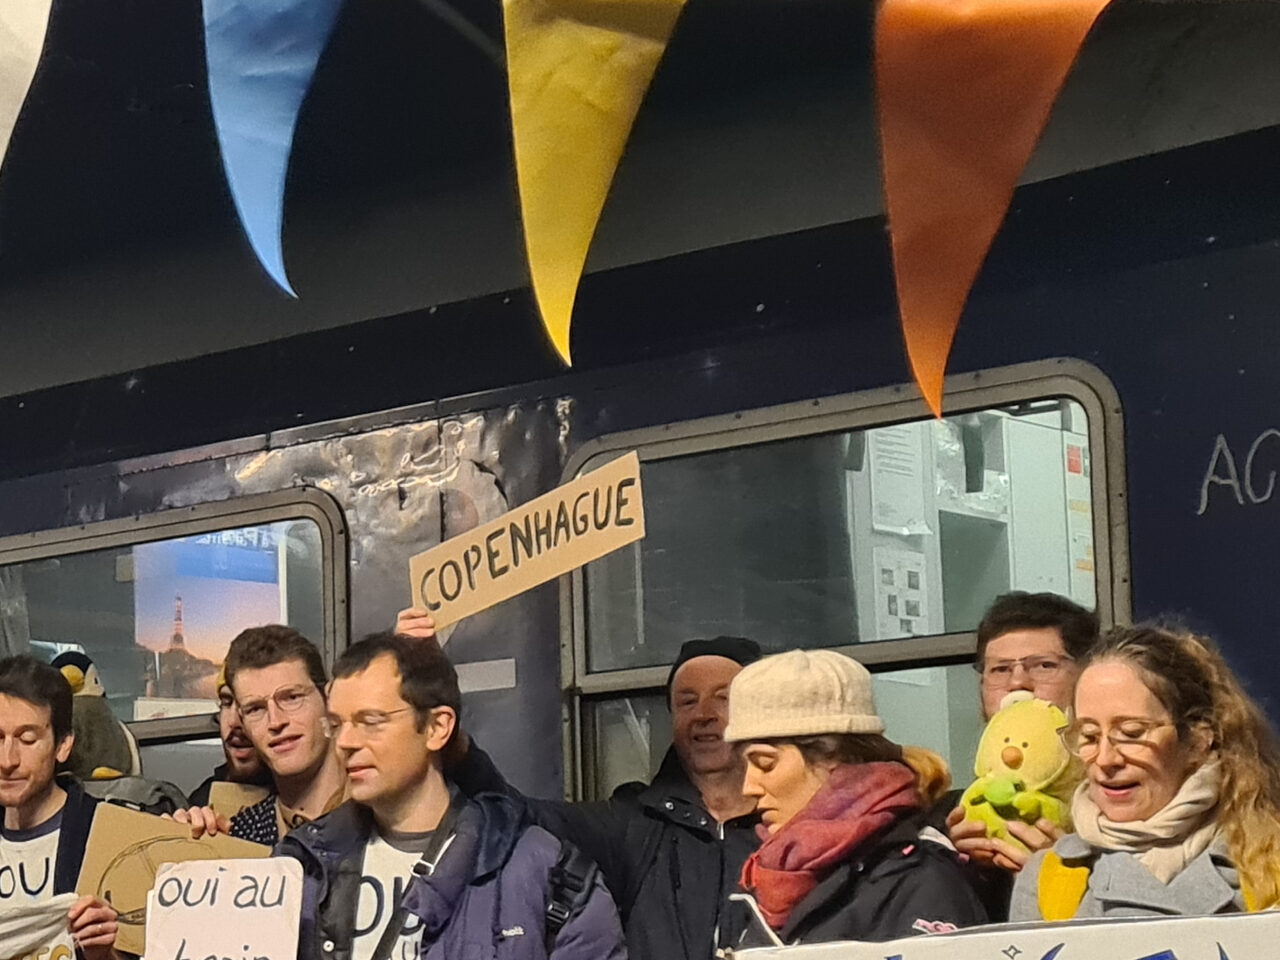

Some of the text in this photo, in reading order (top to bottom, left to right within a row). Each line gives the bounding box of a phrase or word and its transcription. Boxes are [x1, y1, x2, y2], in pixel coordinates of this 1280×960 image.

[420, 477, 636, 611] COPENHAGUE
[158, 867, 286, 908] oui au
